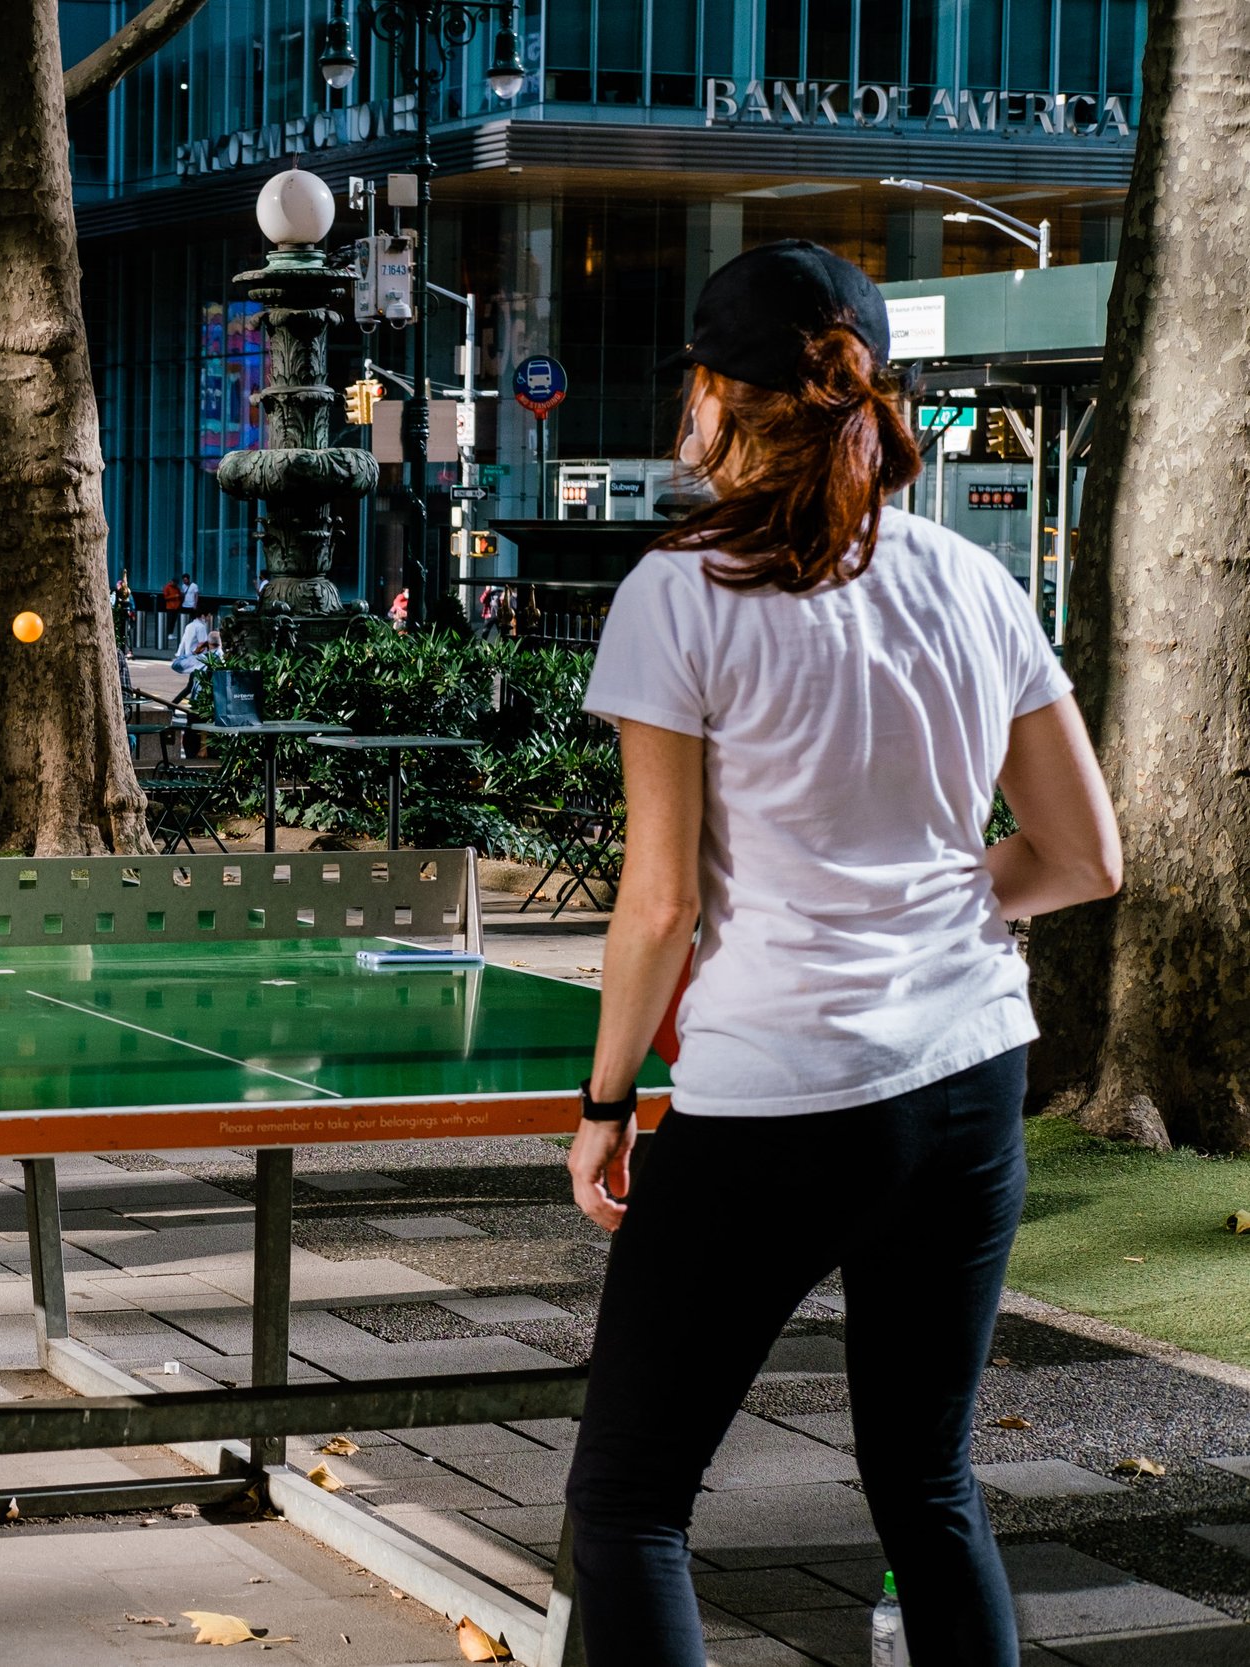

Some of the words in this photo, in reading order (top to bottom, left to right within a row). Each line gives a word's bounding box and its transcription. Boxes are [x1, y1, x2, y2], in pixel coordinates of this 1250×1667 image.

[705, 78, 840, 127] BANK
[852, 85, 914, 128] OF
[924, 88, 1130, 137] AMERICA
[611, 482, 640, 493] Subway
[219, 1121, 253, 1133] Please
[257, 1120, 310, 1132] remember
[314, 1121, 324, 1130] to
[327, 1118, 350, 1129] take
[353, 1119, 376, 1132] your
[380, 1115, 439, 1129] belongings
[442, 1112, 463, 1124] with
[466, 1112, 489, 1127] you!
